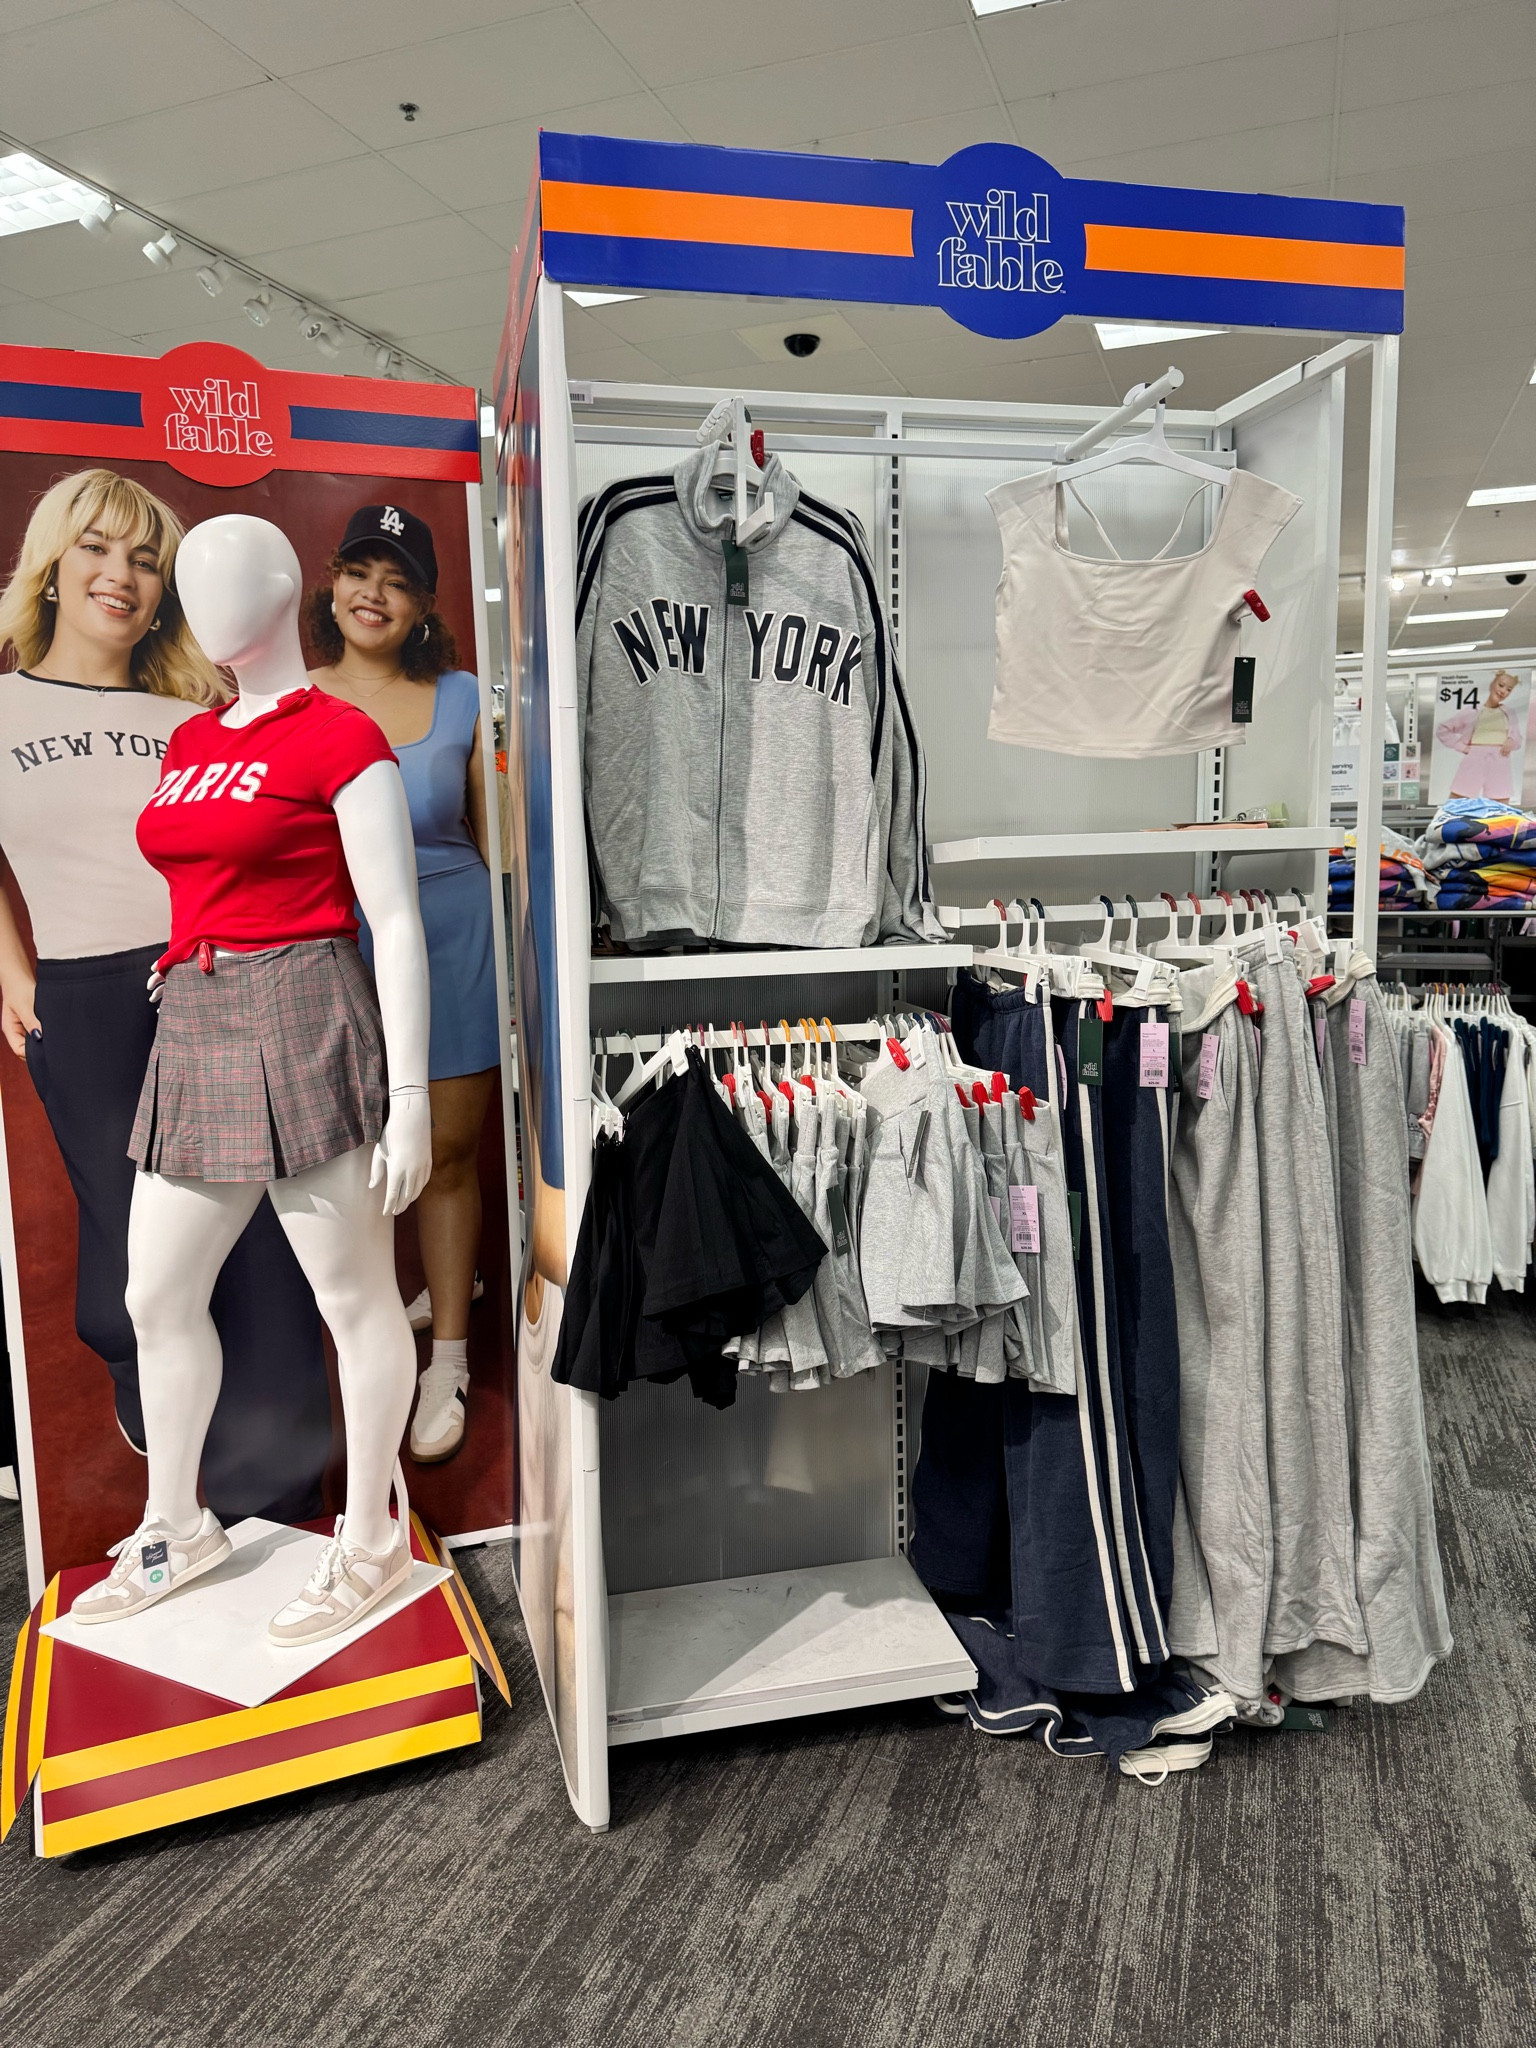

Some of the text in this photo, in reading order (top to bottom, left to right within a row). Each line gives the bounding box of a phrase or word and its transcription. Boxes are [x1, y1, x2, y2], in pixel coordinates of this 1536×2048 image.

[945, 188, 1051, 243] wild
[936, 236, 1064, 294] fable
[168, 378, 261, 419] wild
[163, 413, 273, 456] fable
[380, 505, 404, 536] LA
[610, 597, 862, 709] NEW YORK
[1440, 687, 1480, 710] $14
[11, 731, 93, 772] NEW
[149, 761, 268, 808] PARIS
